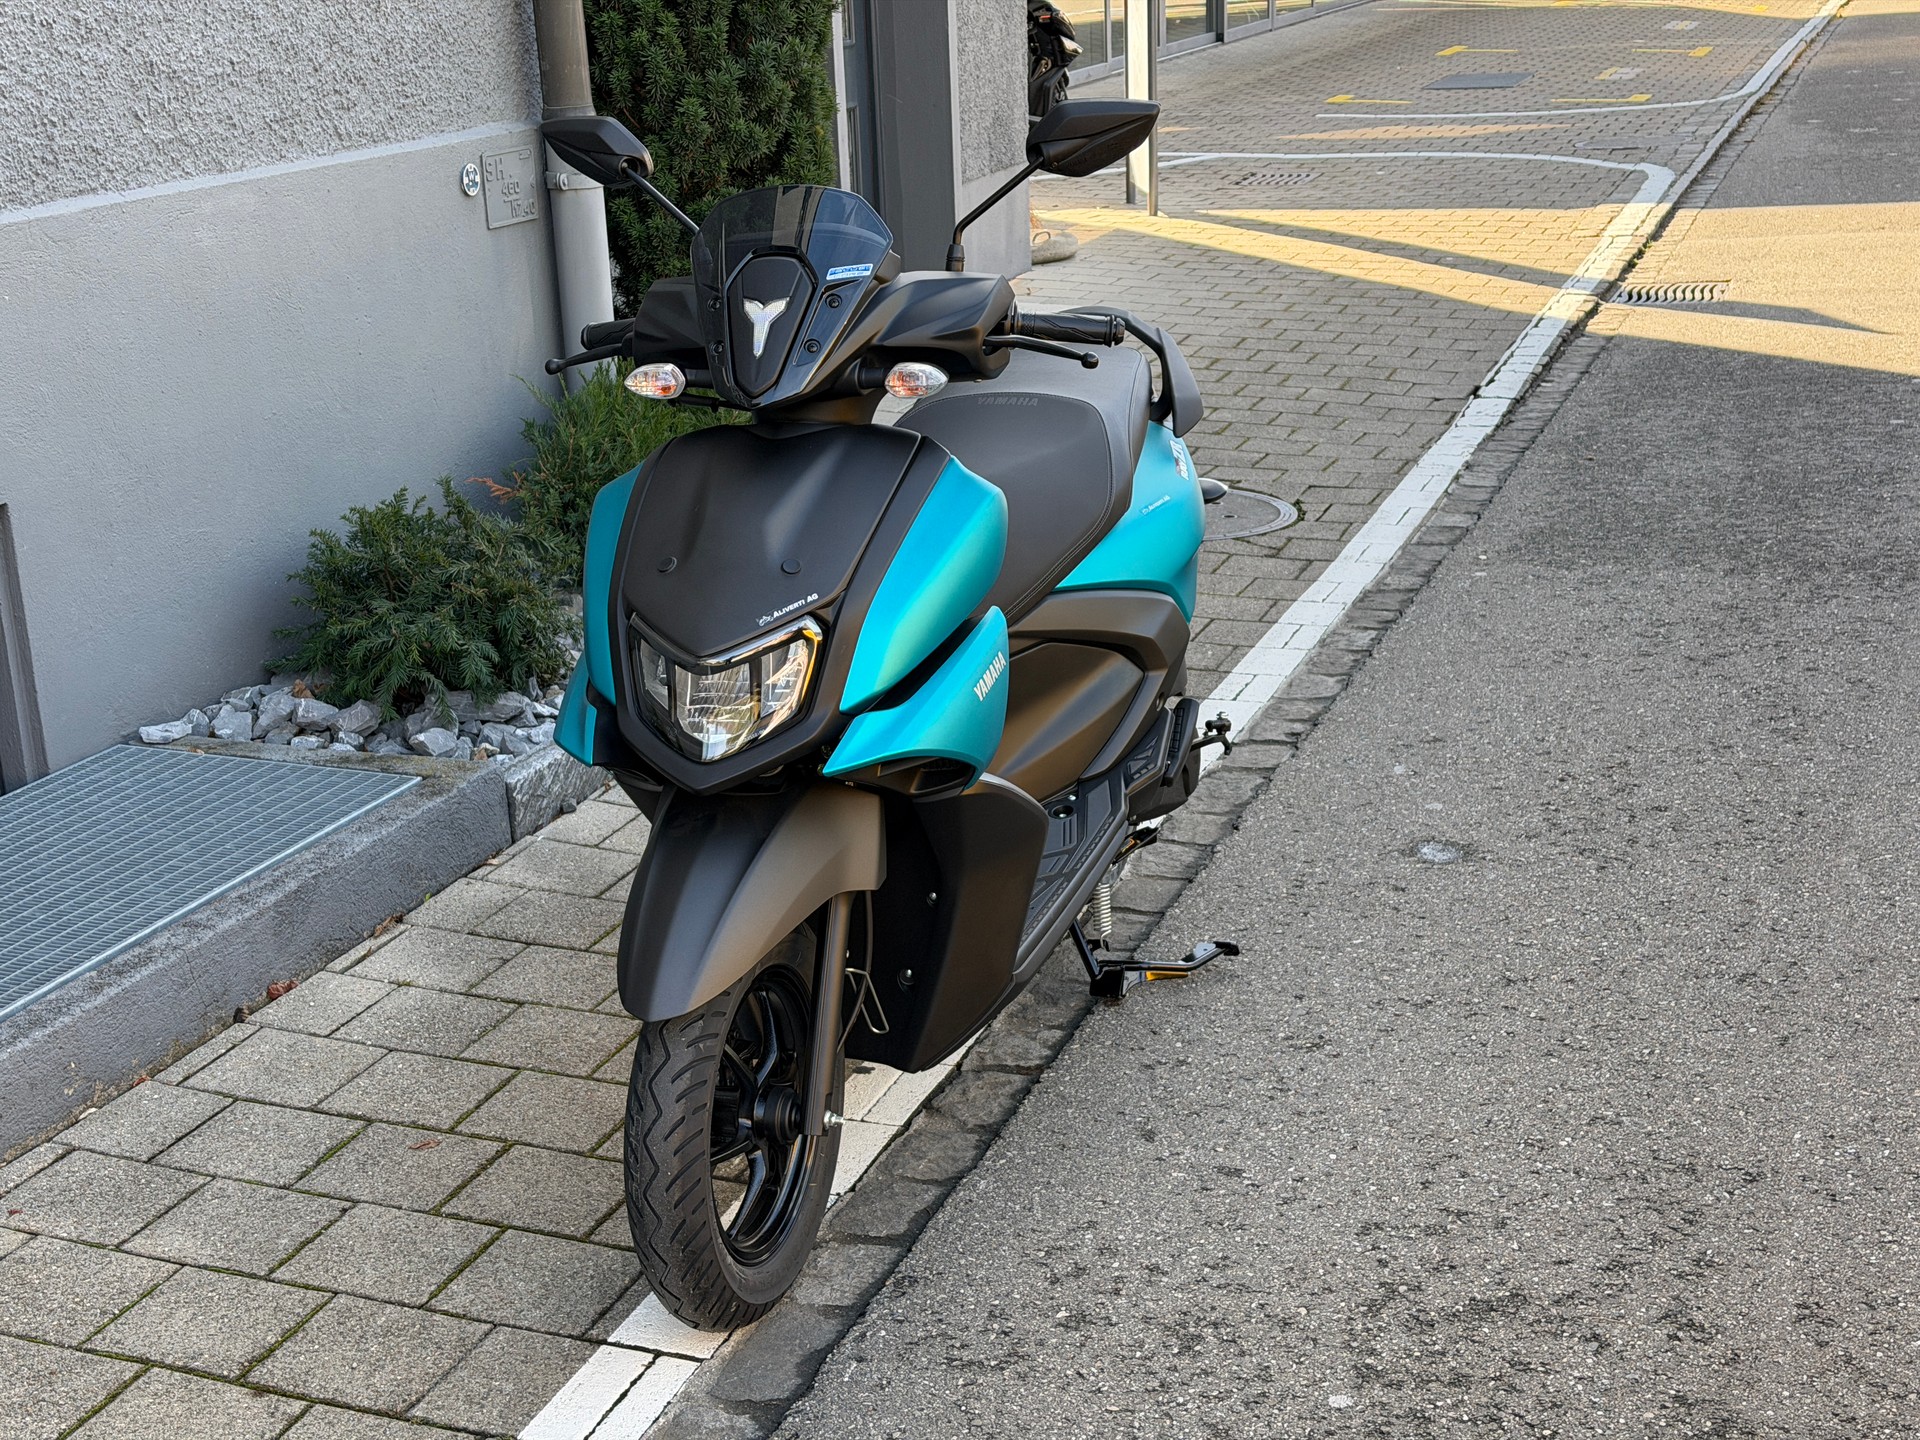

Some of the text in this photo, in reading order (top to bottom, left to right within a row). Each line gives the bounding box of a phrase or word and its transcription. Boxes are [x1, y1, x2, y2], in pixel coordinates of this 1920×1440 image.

[977, 396, 1039, 407] YAMAHA
[773, 592, 819, 618] ALIVERTI AG
[973, 650, 1007, 702] YAMAHA
